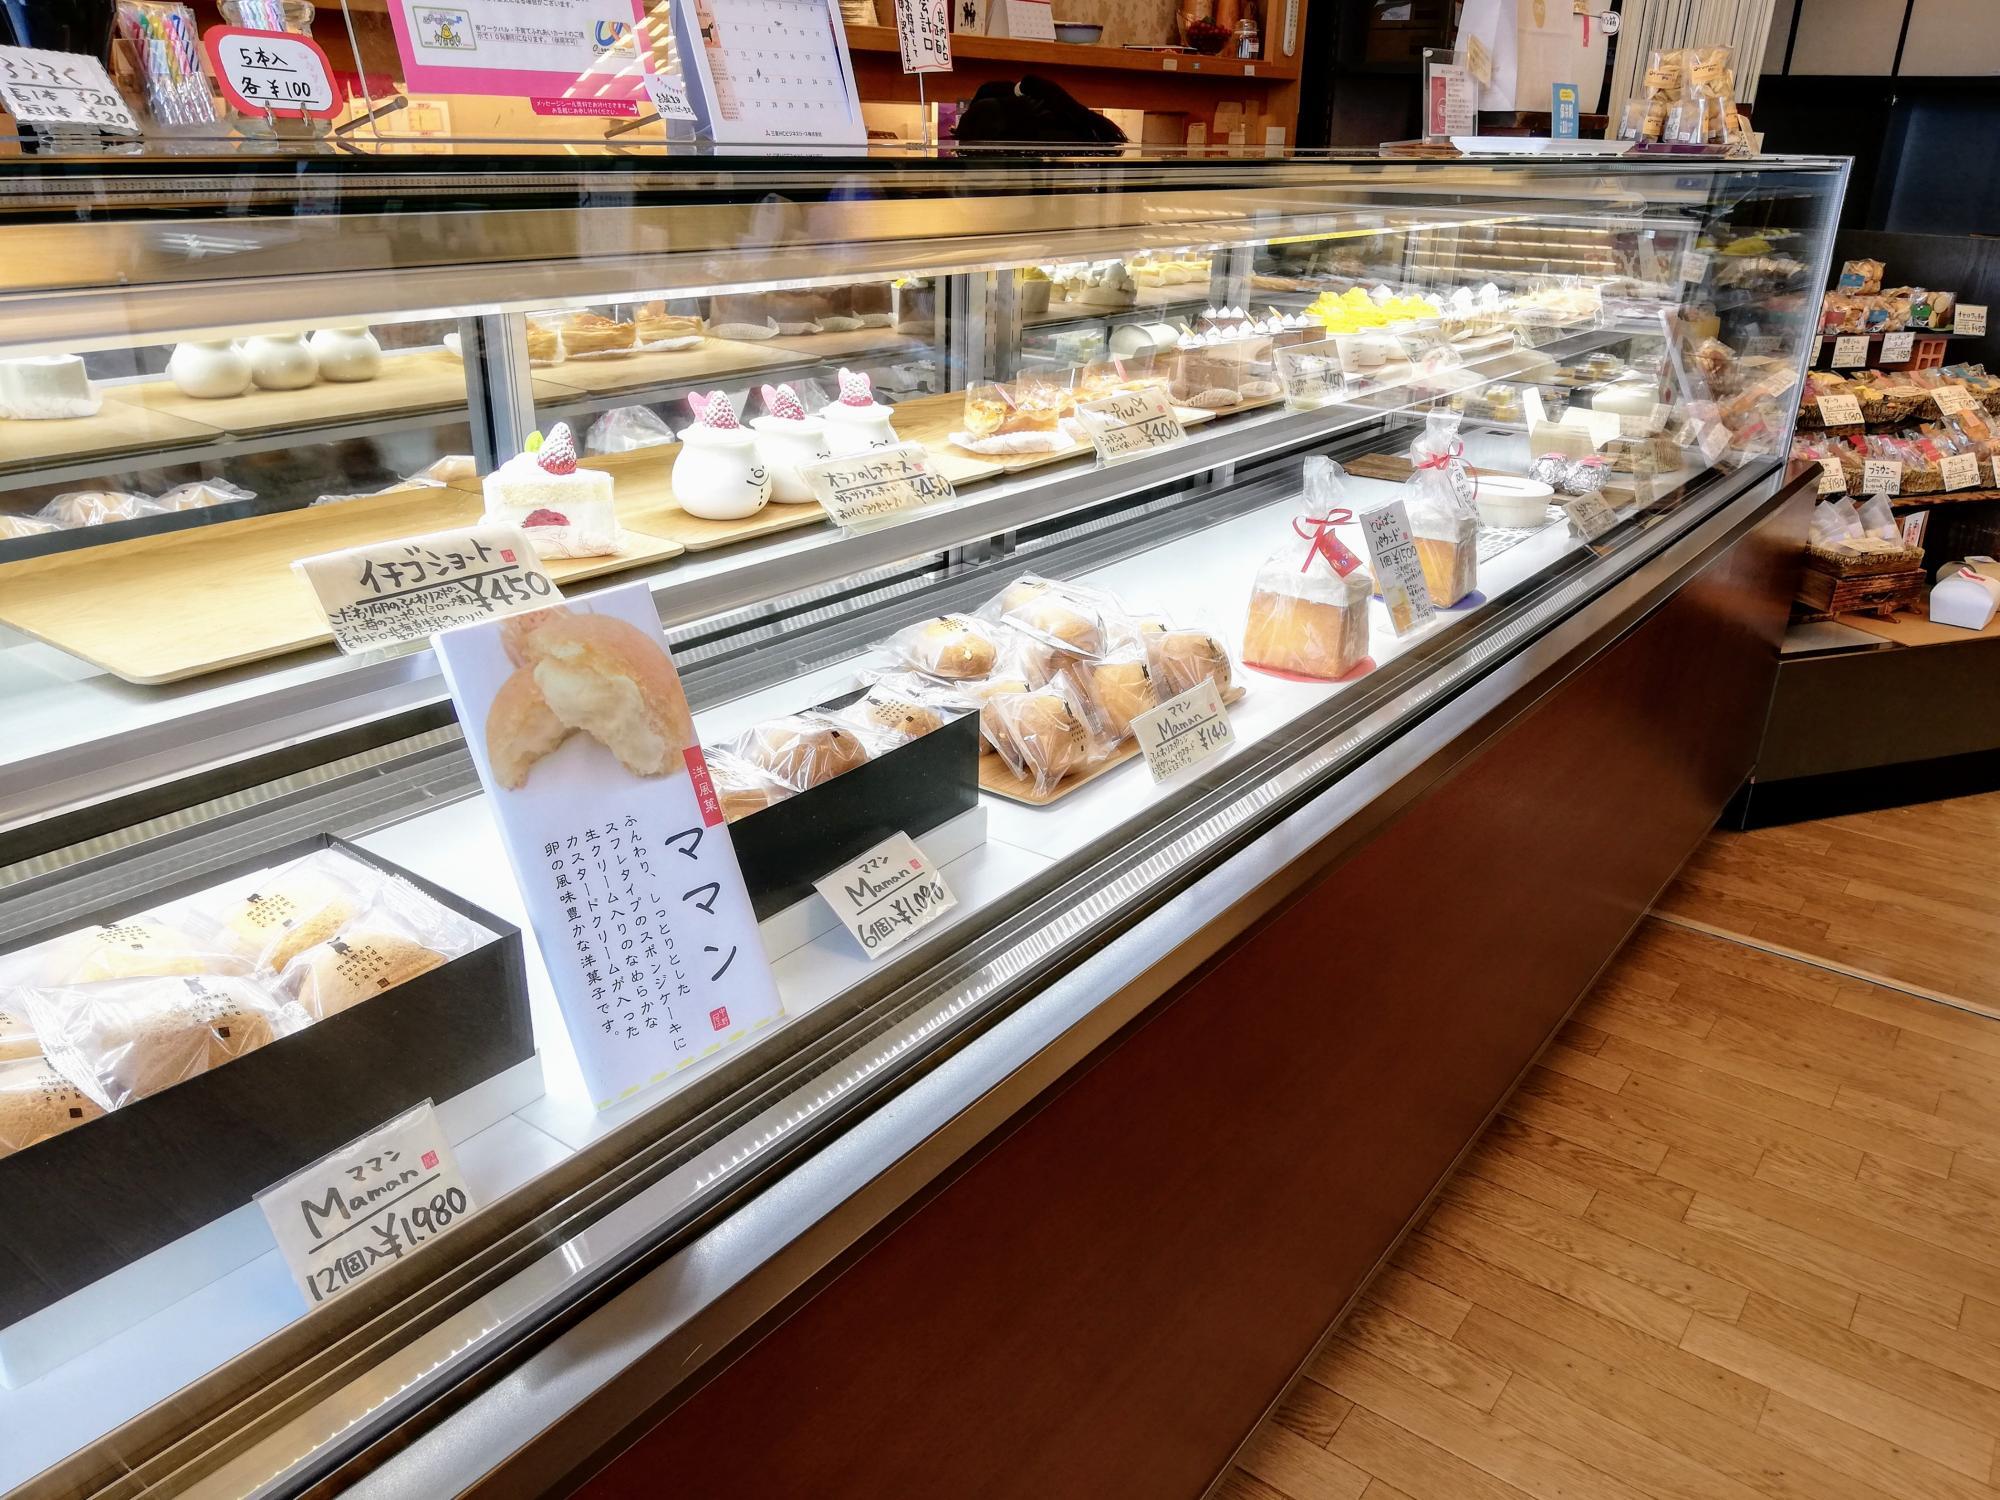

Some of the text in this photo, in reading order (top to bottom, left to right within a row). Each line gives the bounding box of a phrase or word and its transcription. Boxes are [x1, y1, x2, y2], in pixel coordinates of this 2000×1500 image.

[240, 47, 288, 68] 5本入
[242, 76, 311, 98] 各 ¥100
[1137, 420, 1179, 447] ¥400
[1868, 463, 1898, 476] ブラウニー
[1375, 527, 1400, 551] パウンド
[360, 538, 492, 593] イチゴショート
[459, 571, 551, 612] ¥450
[1168, 700, 1191, 716] ママン
[1157, 714, 1203, 740] Maman
[1197, 721, 1227, 750] ¥140
[692, 766, 718, 813] 洋風菓
[858, 856, 889, 874] ママン
[844, 869, 910, 907] Maman
[623, 815, 691, 995] ふんわり、しっとりとした
[664, 826, 737, 983] ママン
[544, 842, 620, 1037] 卵の風味豊かな洋菓子です。
[566, 835, 640, 1039] カスタードクリームが入った
[585, 829, 659, 1029] 生クリーム入りのなめらかな
[605, 822, 687, 1051] スフレタイプのスポンジケーキに
[858, 915, 901, 948] 6個入
[336, 945, 371, 972] maman
[343, 949, 377, 976] custard
[349, 955, 384, 981] cream
[354, 960, 391, 987] cake
[345, 1150, 401, 1182] ママン
[301, 1169, 419, 1239] Maman
[306, 1246, 385, 1301] 12個入
